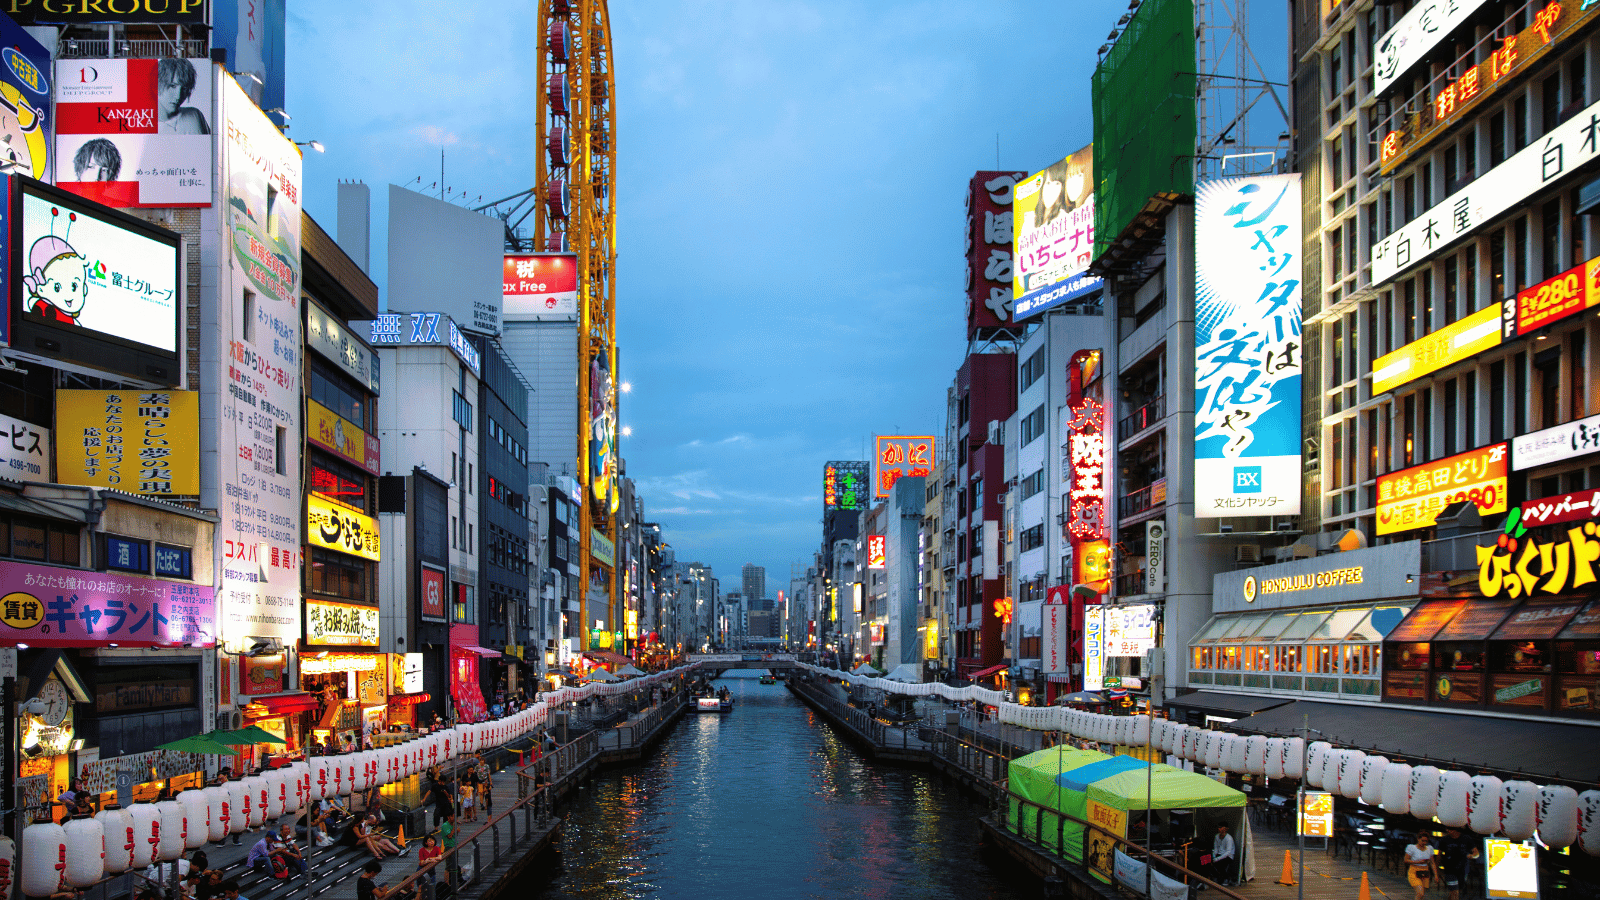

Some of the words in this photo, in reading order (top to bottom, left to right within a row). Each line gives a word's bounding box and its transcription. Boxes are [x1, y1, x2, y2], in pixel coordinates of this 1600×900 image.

[97, 106, 154, 124] KANZAKI
[118, 116, 154, 132] RUKA
[136, 167, 197, 178] めっちゃ面白いを
[179, 177, 206, 188] 仕事に。
[1396, 196, 1472, 269] 白木屋
[516, 260, 534, 279] 税
[112, 271, 174, 301] 富士グループ
[502, 284, 516, 292] ax
[520, 281, 546, 292] Free
[370, 312, 441, 343] 無双
[1503, 298, 1516, 338] 3F
[83, 427, 102, 478] 応援します
[105, 394, 124, 485] あなたのお店づくり
[138, 392, 172, 493] 素晴らしい夢の実現
[882, 442, 930, 466] かに
[1069, 398, 1104, 539] 大阪王将
[1236, 472, 1260, 488] BX
[1378, 454, 1489, 503] 豊後高田どり
[1488, 444, 1506, 464] 2F
[320, 508, 364, 552] うなぎ
[118, 542, 130, 566] 酒
[156, 550, 180, 572] たばこ
[225, 540, 258, 563] コスパ
[24, 572, 166, 598] あなたも憧れのお店のオーナーに！
[427, 580, 439, 606] G3
[1260, 572, 1315, 596] HONOLULU
[1316, 566, 1364, 587] COFFEE
[4, 600, 38, 621] 賃貸
[40, 624, 50, 634] の
[46, 594, 168, 636] ギャラント
[324, 606, 360, 634] お好み焼
[1088, 622, 1100, 658] タイコク
[115, 683, 180, 708] FamilyMart
